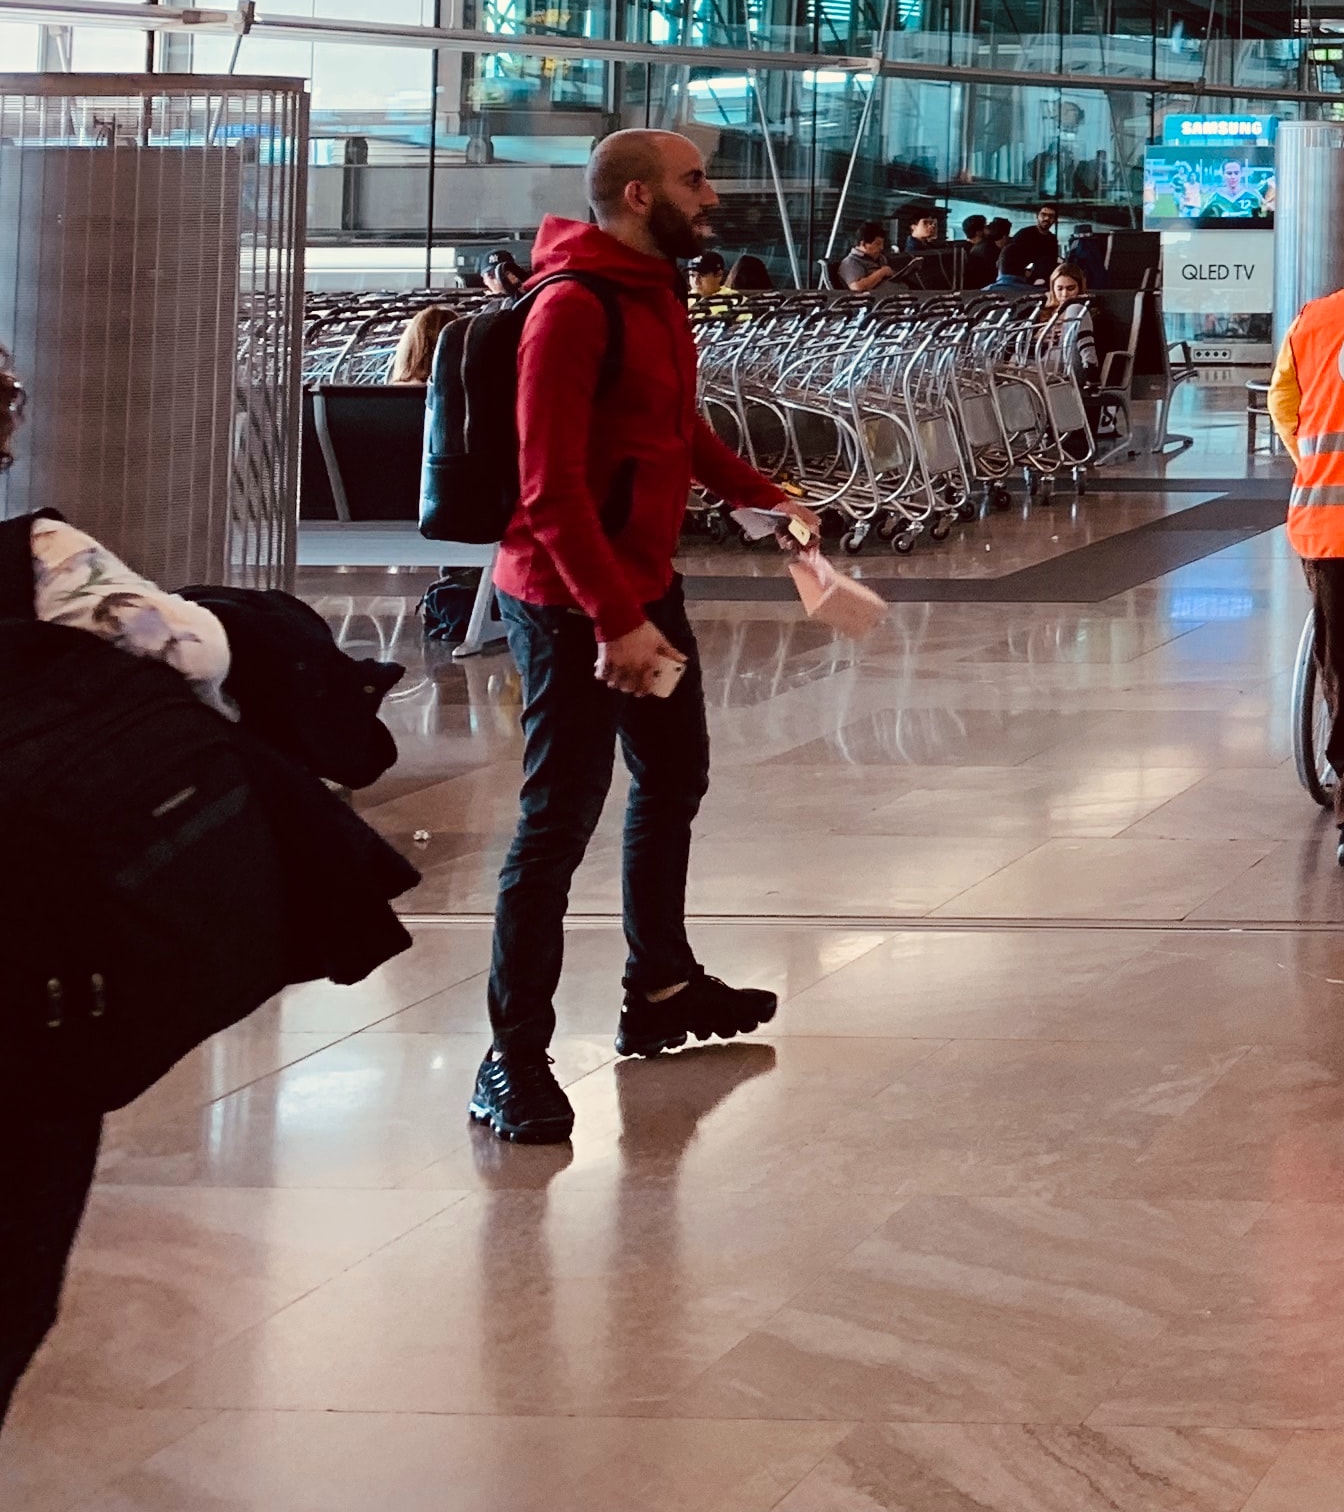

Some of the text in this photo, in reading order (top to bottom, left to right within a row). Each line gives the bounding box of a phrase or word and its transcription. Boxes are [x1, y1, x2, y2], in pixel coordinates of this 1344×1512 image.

[1181, 120, 1263, 136] SAMSUNG
[1181, 264, 1255, 281] QLED TV
